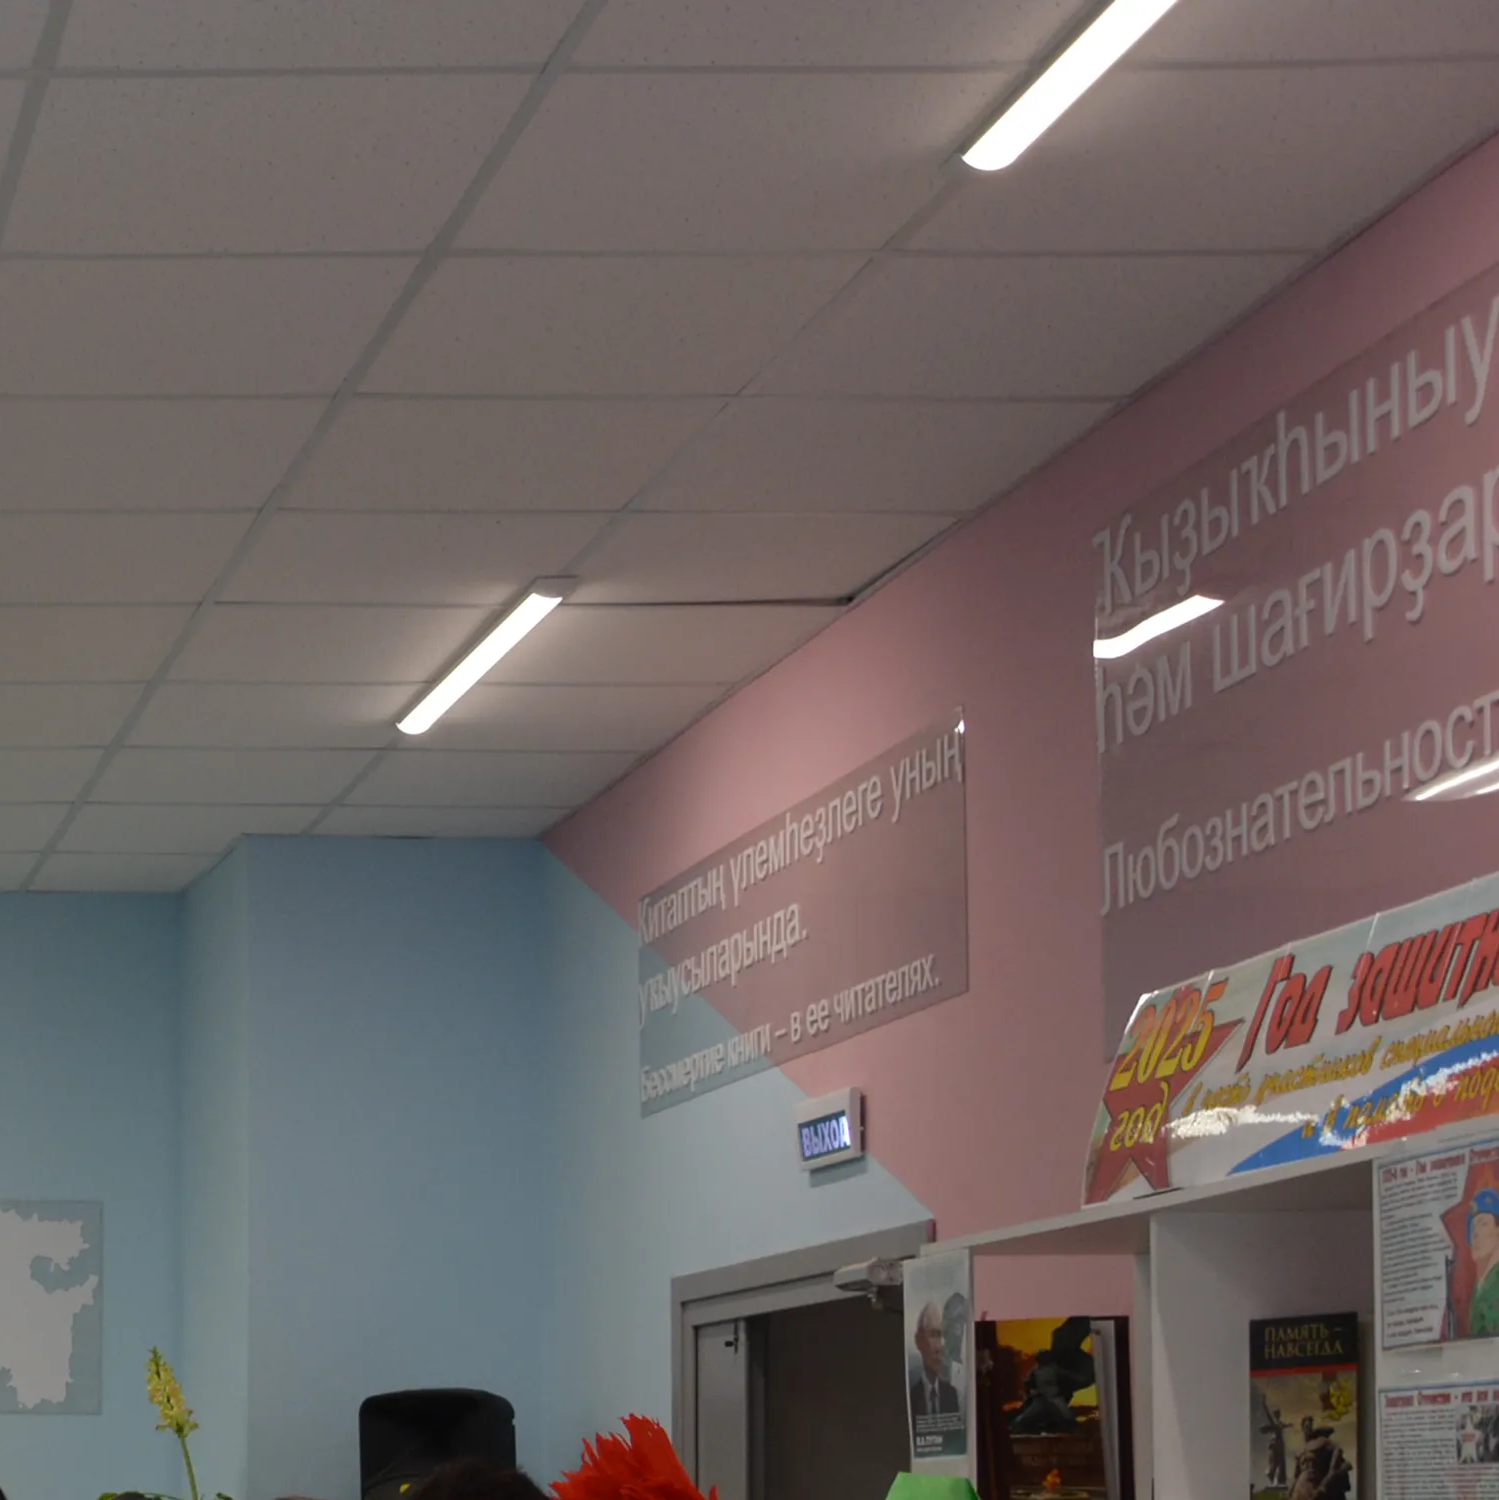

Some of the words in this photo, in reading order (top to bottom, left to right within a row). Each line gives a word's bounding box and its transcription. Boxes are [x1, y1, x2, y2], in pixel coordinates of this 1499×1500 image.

[1096, 641, 1191, 754] һәм
[638, 865, 726, 944] Китаптың
[640, 1043, 725, 1100] Бессмертие
[727, 1026, 771, 1067] книги
[790, 1016, 801, 1042] в
[806, 998, 830, 1037] ее
[833, 954, 941, 1024] читателях.
[1109, 978, 1229, 1091] 2025
[801, 1116, 851, 1157] ВЫХОД
[1264, 1340, 1343, 1359] НАВСЕГДА
[1265, 1323, 1329, 1342] ПАМЯТЬ
